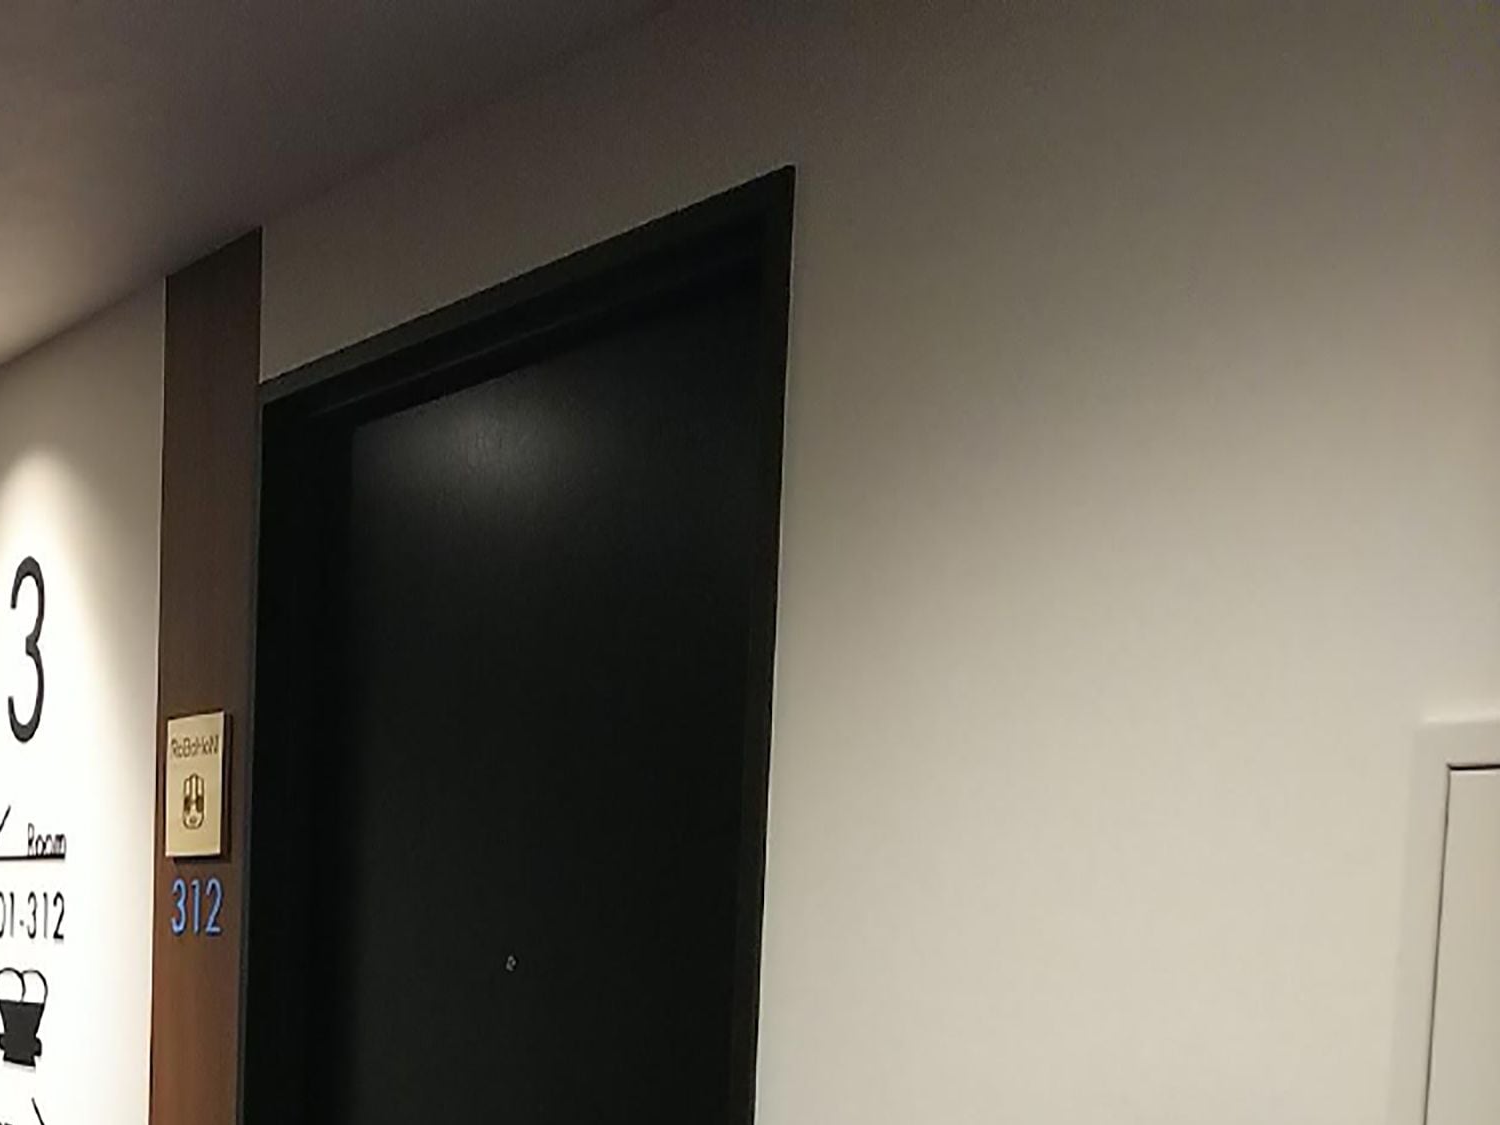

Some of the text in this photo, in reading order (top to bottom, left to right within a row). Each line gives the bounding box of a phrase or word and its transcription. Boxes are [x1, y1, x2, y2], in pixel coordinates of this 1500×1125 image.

[7, 556, 46, 743] 3
[27, 823, 67, 856] Room
[171, 878, 223, 935] 312
